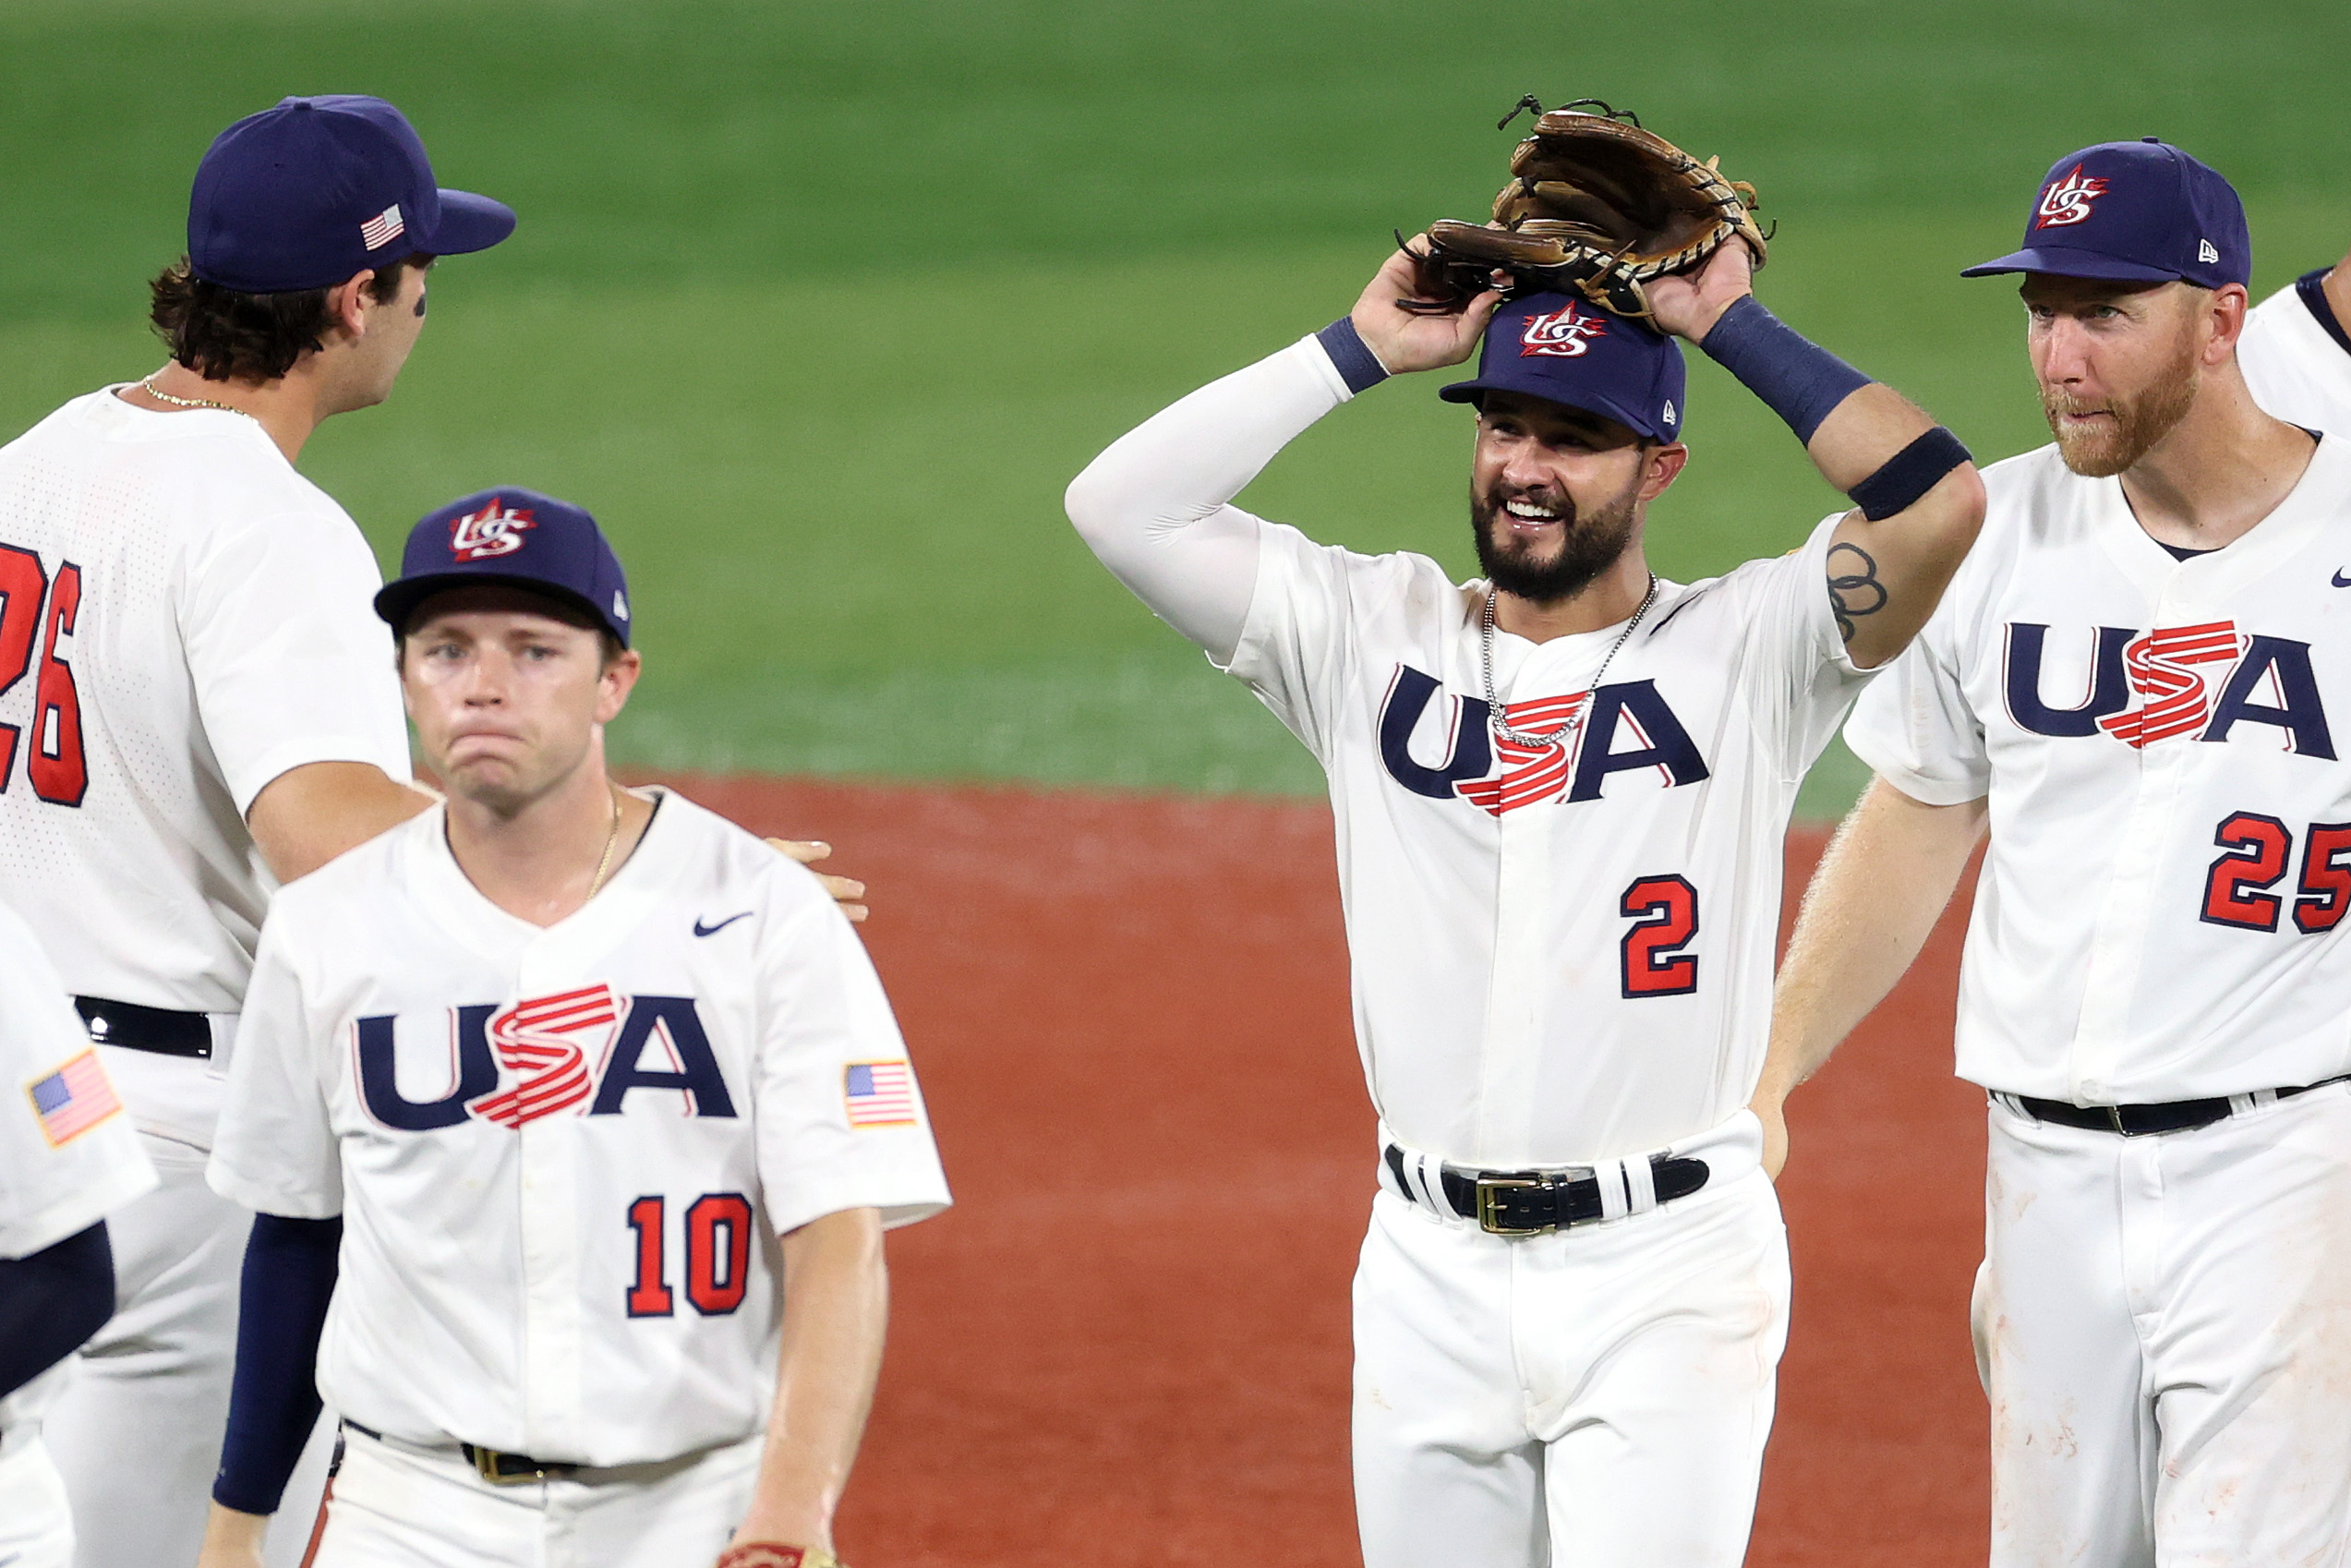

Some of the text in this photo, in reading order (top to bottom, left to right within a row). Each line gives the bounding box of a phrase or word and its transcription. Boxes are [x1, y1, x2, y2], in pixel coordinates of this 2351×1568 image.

[1376, 662, 1709, 817] USA
[2003, 618, 2339, 761] USA
[1621, 874, 1698, 999] 2
[2200, 810, 2351, 935] 25
[351, 981, 738, 1131] USA
[626, 1192, 753, 1318] 10
